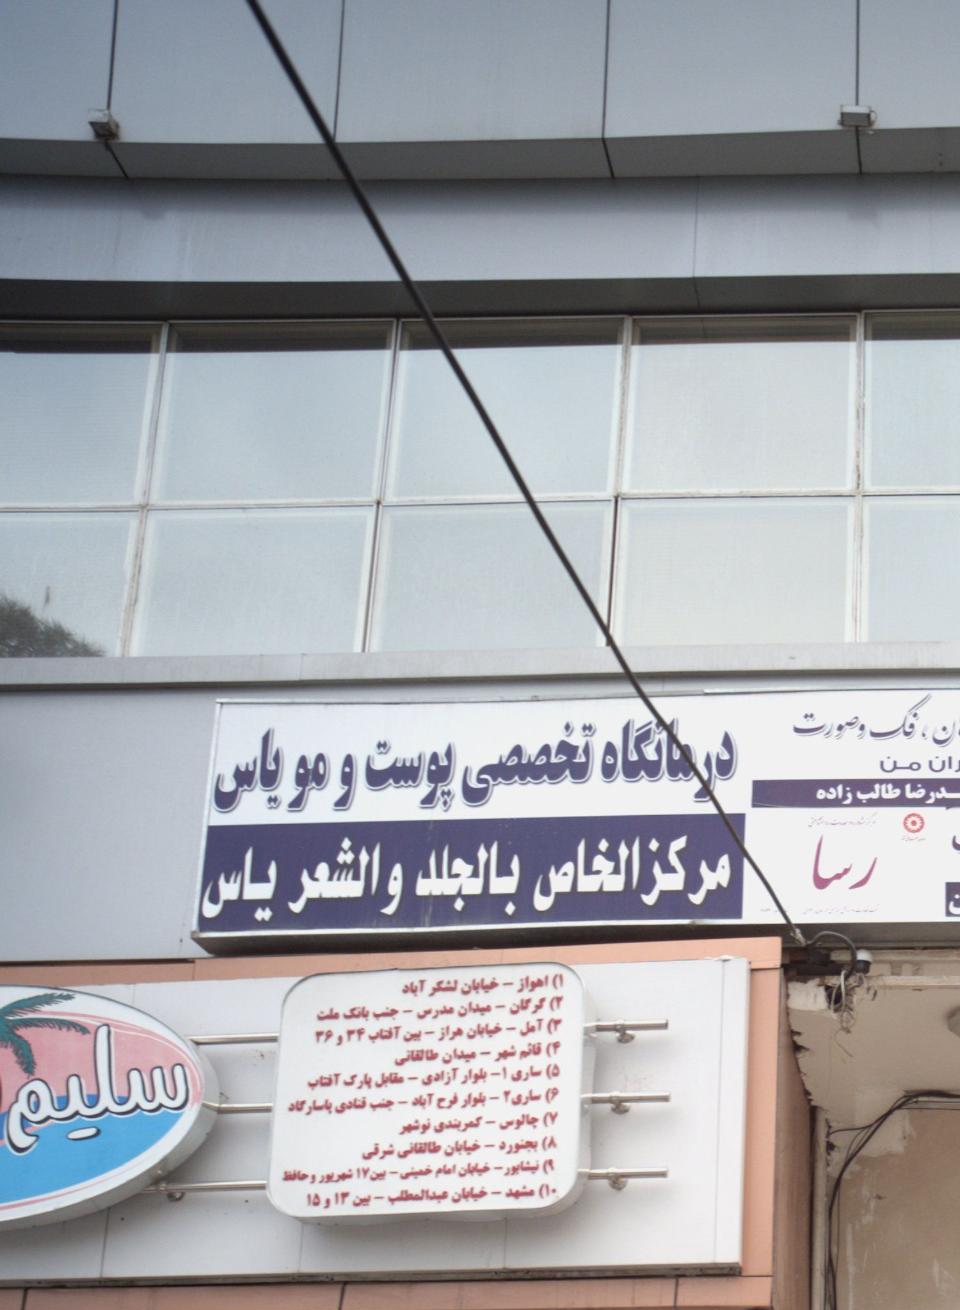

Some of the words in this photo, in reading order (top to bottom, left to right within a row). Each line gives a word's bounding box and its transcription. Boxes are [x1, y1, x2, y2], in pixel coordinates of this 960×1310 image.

[213, 727, 284, 813] یاس
[287, 750, 331, 812] مو
[333, 750, 354, 810] و
[365, 739, 457, 811] پوست
[461, 720, 597, 807] تخصصی
[600, 718, 736, 803] درمانگاه
[879, 756, 921, 774] من
[415, 842, 521, 917] بالجلد
[812, 834, 878, 891] رسا
[6, 1023, 190, 1155] سلیم
